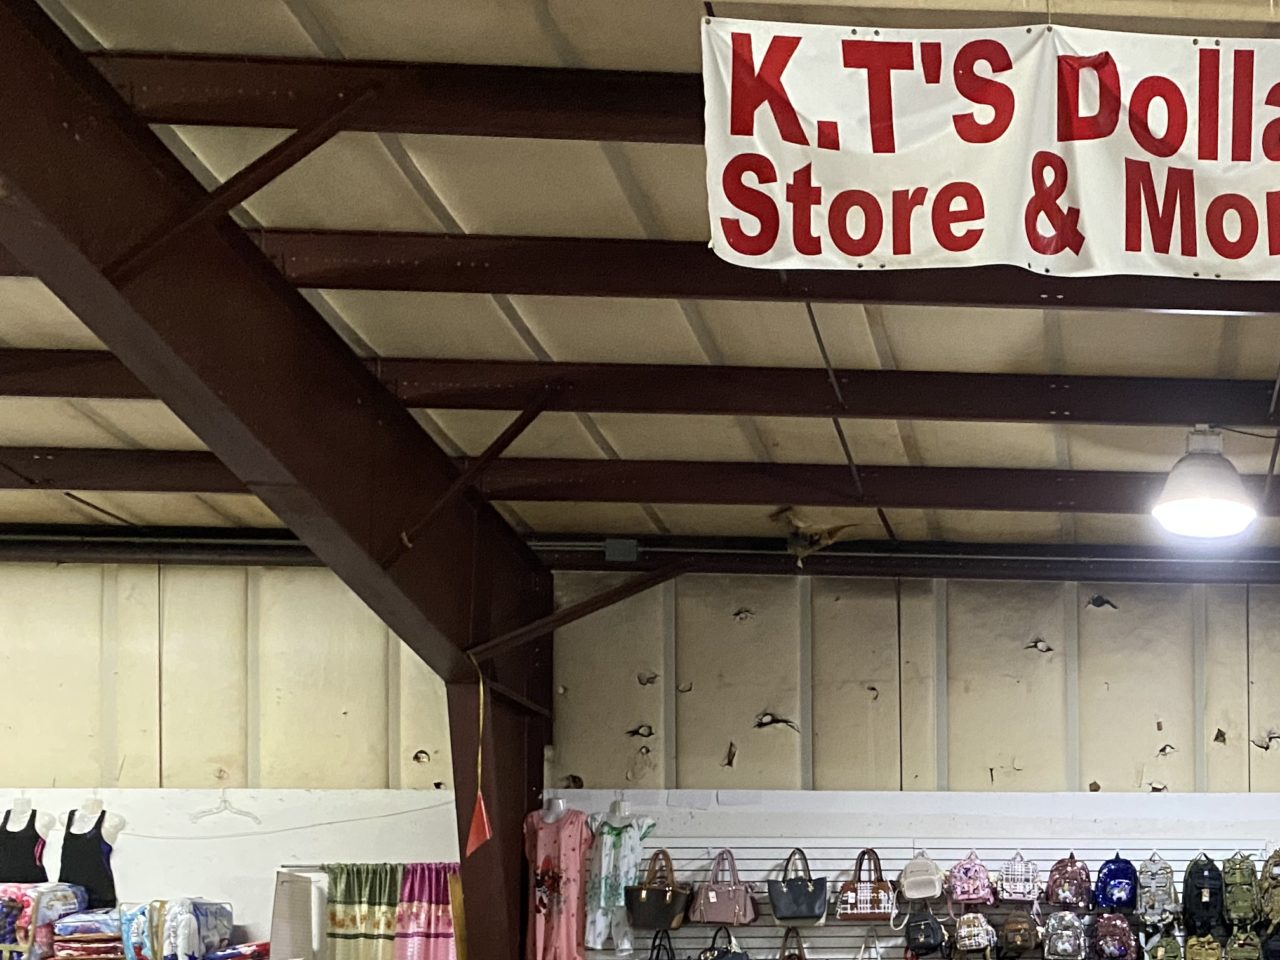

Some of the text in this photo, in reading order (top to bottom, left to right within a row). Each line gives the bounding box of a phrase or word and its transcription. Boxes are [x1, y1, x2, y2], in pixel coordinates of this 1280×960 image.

[729, 32, 1015, 154] K.T'S
[720, 153, 985, 256] Store
[1025, 151, 1085, 257] &
